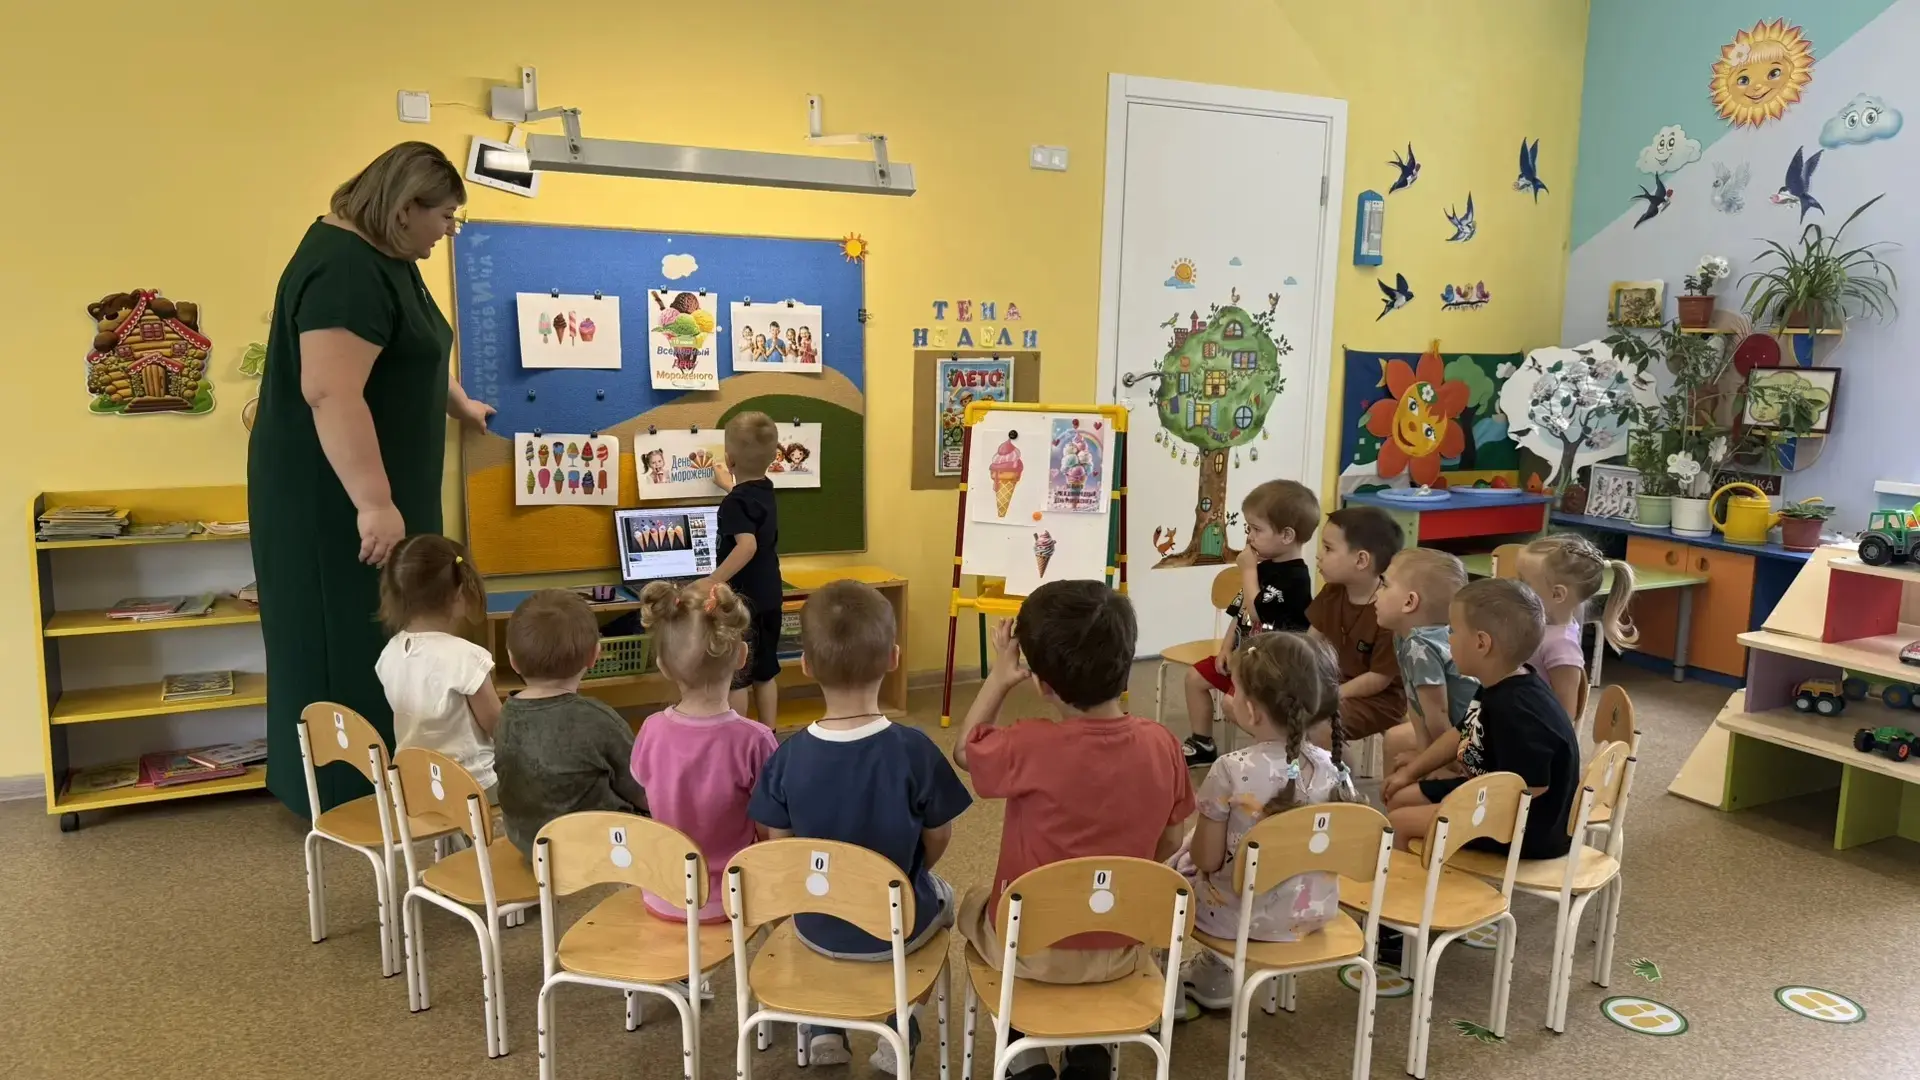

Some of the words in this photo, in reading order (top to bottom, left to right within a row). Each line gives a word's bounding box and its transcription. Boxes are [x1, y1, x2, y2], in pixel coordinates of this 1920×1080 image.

[656, 370, 714, 381] Мороженого
[951, 368, 1003, 388] ЛЕТО
[671, 454, 692, 471] День
[671, 467, 714, 483] мороженог
[1318, 816, 1326, 829] 0
[614, 831, 622, 843] 0
[815, 857, 824, 870] 0
[1097, 872, 1106, 885] 0
